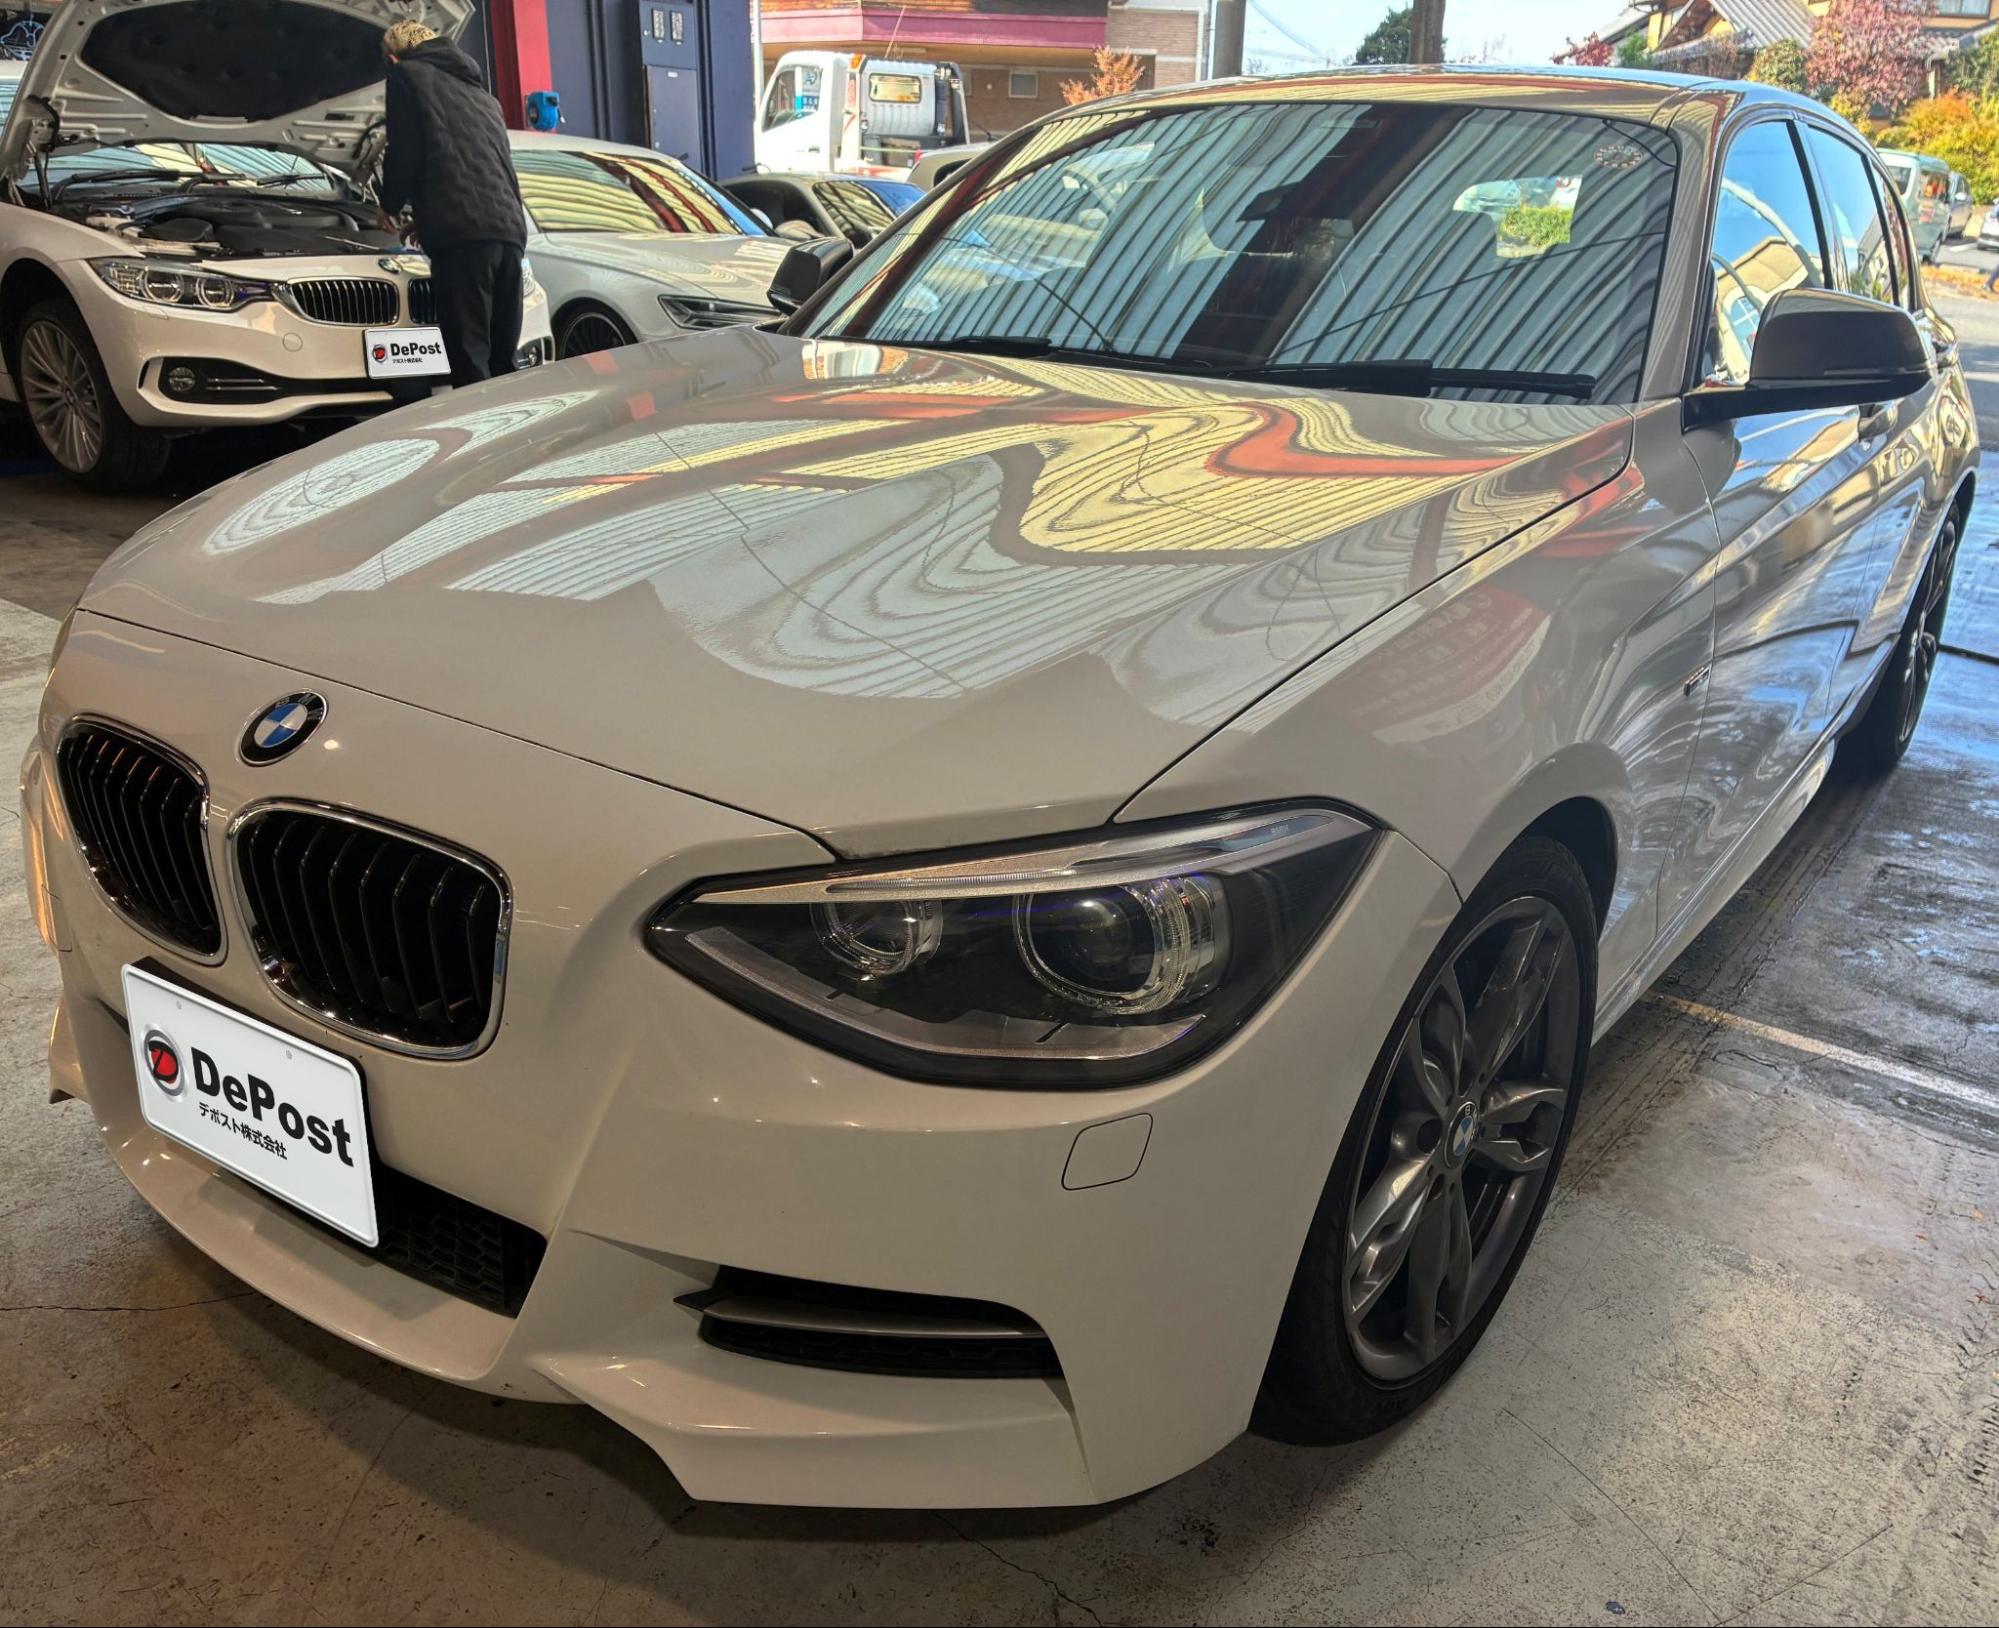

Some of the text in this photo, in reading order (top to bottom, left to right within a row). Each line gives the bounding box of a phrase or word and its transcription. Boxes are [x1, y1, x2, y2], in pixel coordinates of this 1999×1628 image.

[390, 342, 442, 356] DePost
[190, 1046, 354, 1167] DePost
[199, 1101, 288, 1160] デポスト株式会社
